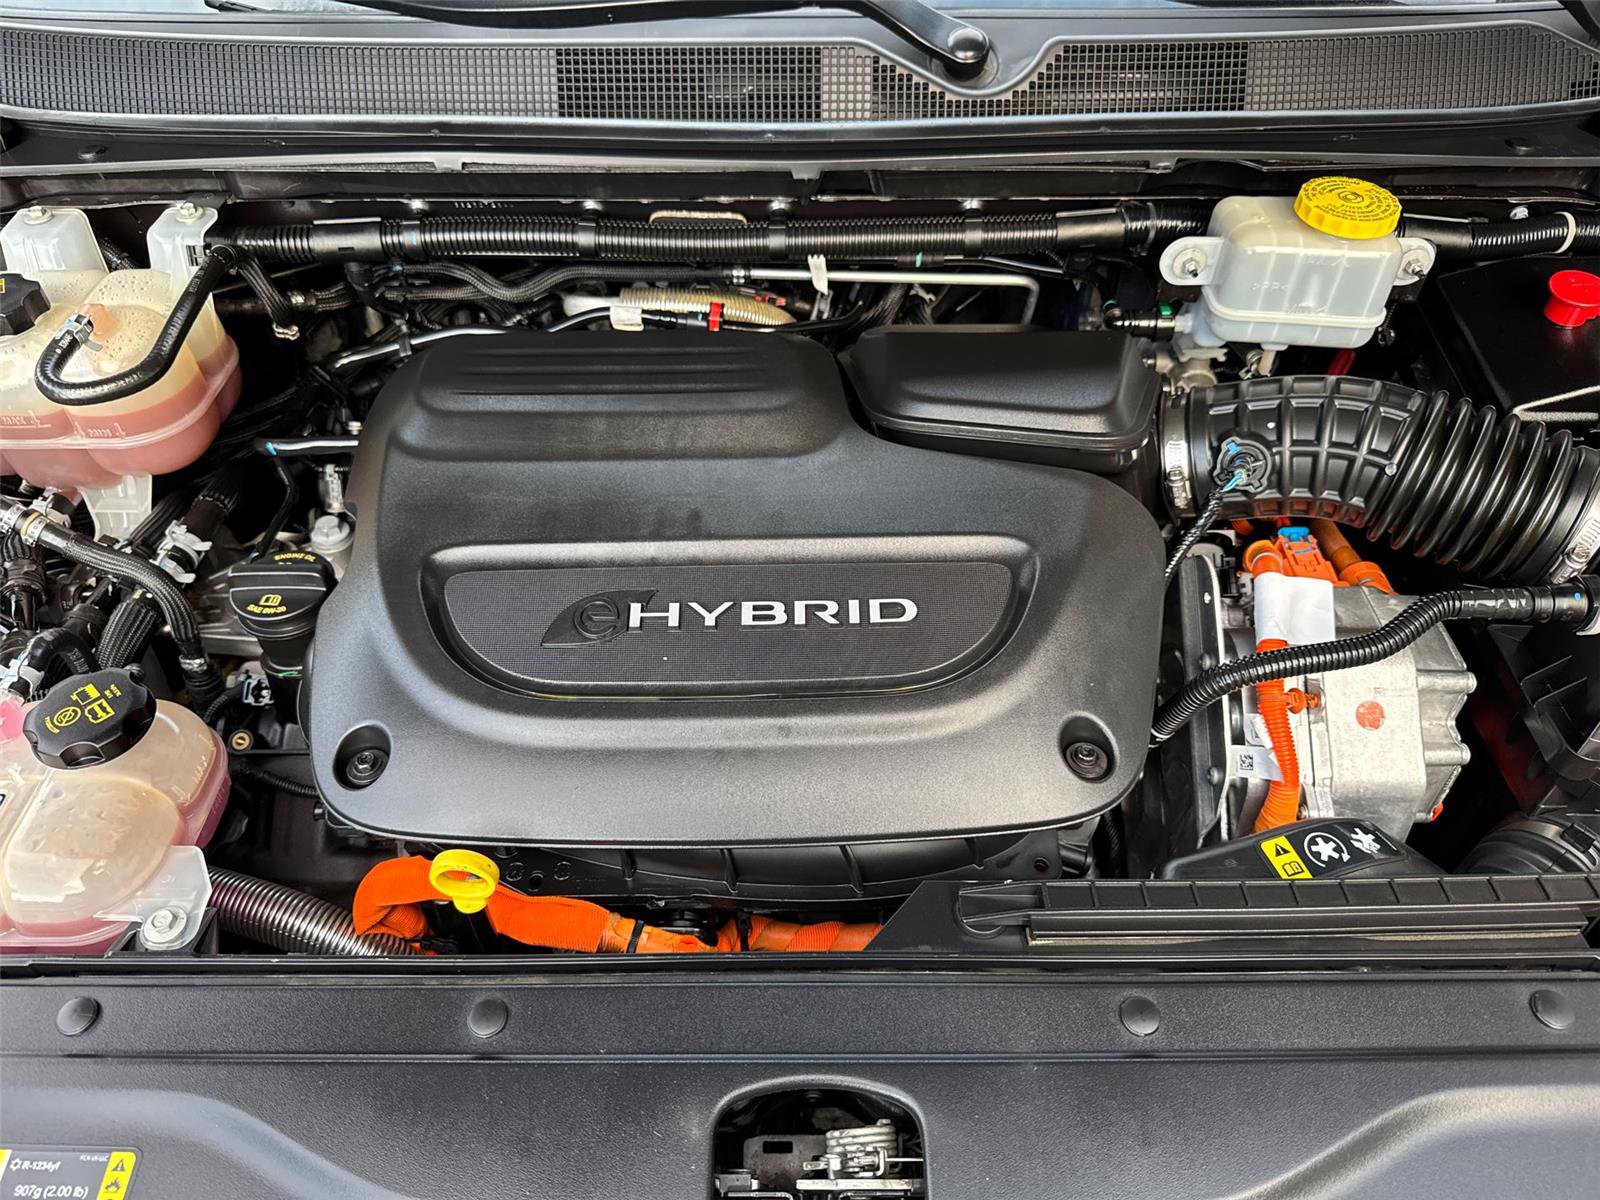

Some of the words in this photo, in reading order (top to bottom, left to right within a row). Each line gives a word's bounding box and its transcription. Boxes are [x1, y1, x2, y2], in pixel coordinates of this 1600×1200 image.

[246, 604, 262, 614] SAE
[627, 598, 918, 628] HYBRID
[22, 1160, 61, 1172] R-1234yf
[13, 1184, 43, 1200] 907g
[43, 1184, 73, 1200] (2.00
[73, 1185, 89, 1200] lb)
